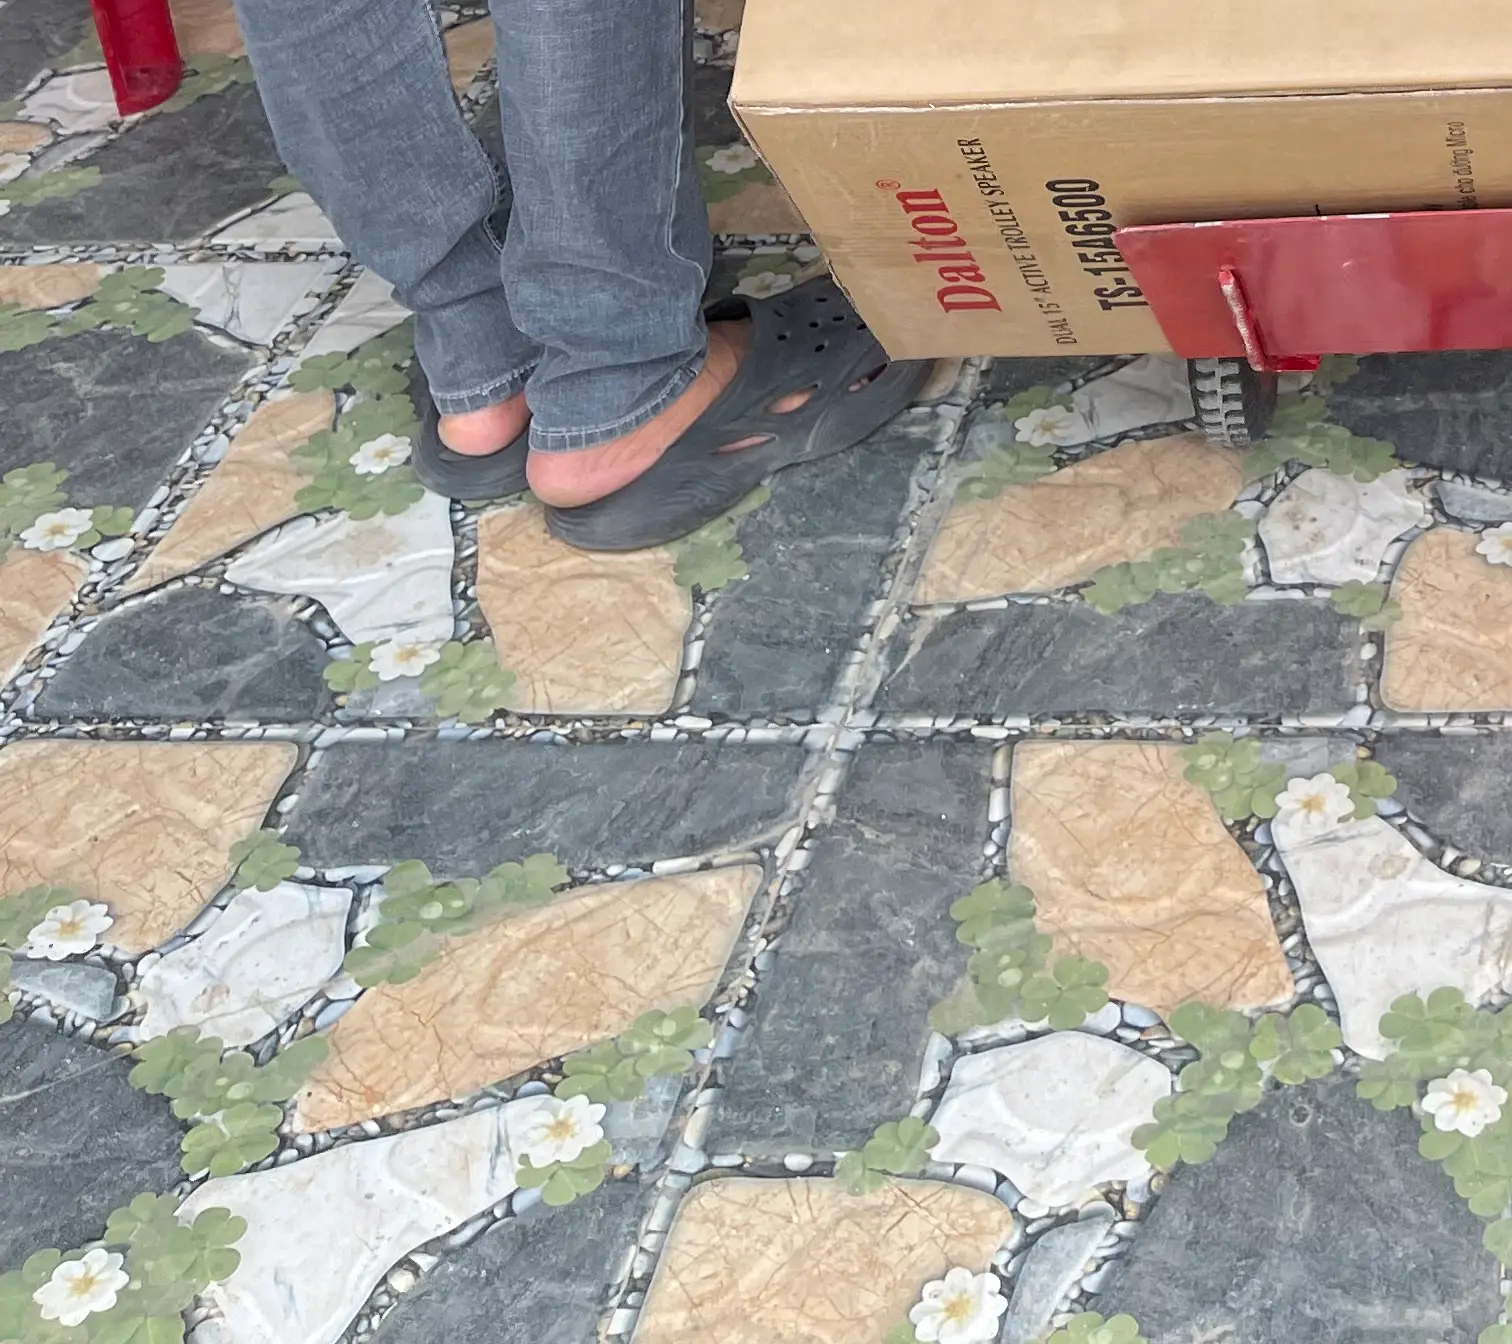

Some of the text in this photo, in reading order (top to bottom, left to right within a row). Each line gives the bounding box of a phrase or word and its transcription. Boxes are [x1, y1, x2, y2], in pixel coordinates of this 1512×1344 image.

[1445, 120, 1468, 149] Micro
[956, 136, 1005, 197] SPEAKER
[985, 198, 1031, 254] TROLLEY
[1045, 179, 1150, 311] TS-15A6500
[1013, 253, 1053, 296] ACTIVE
[1048, 315, 1078, 345] DUAL
